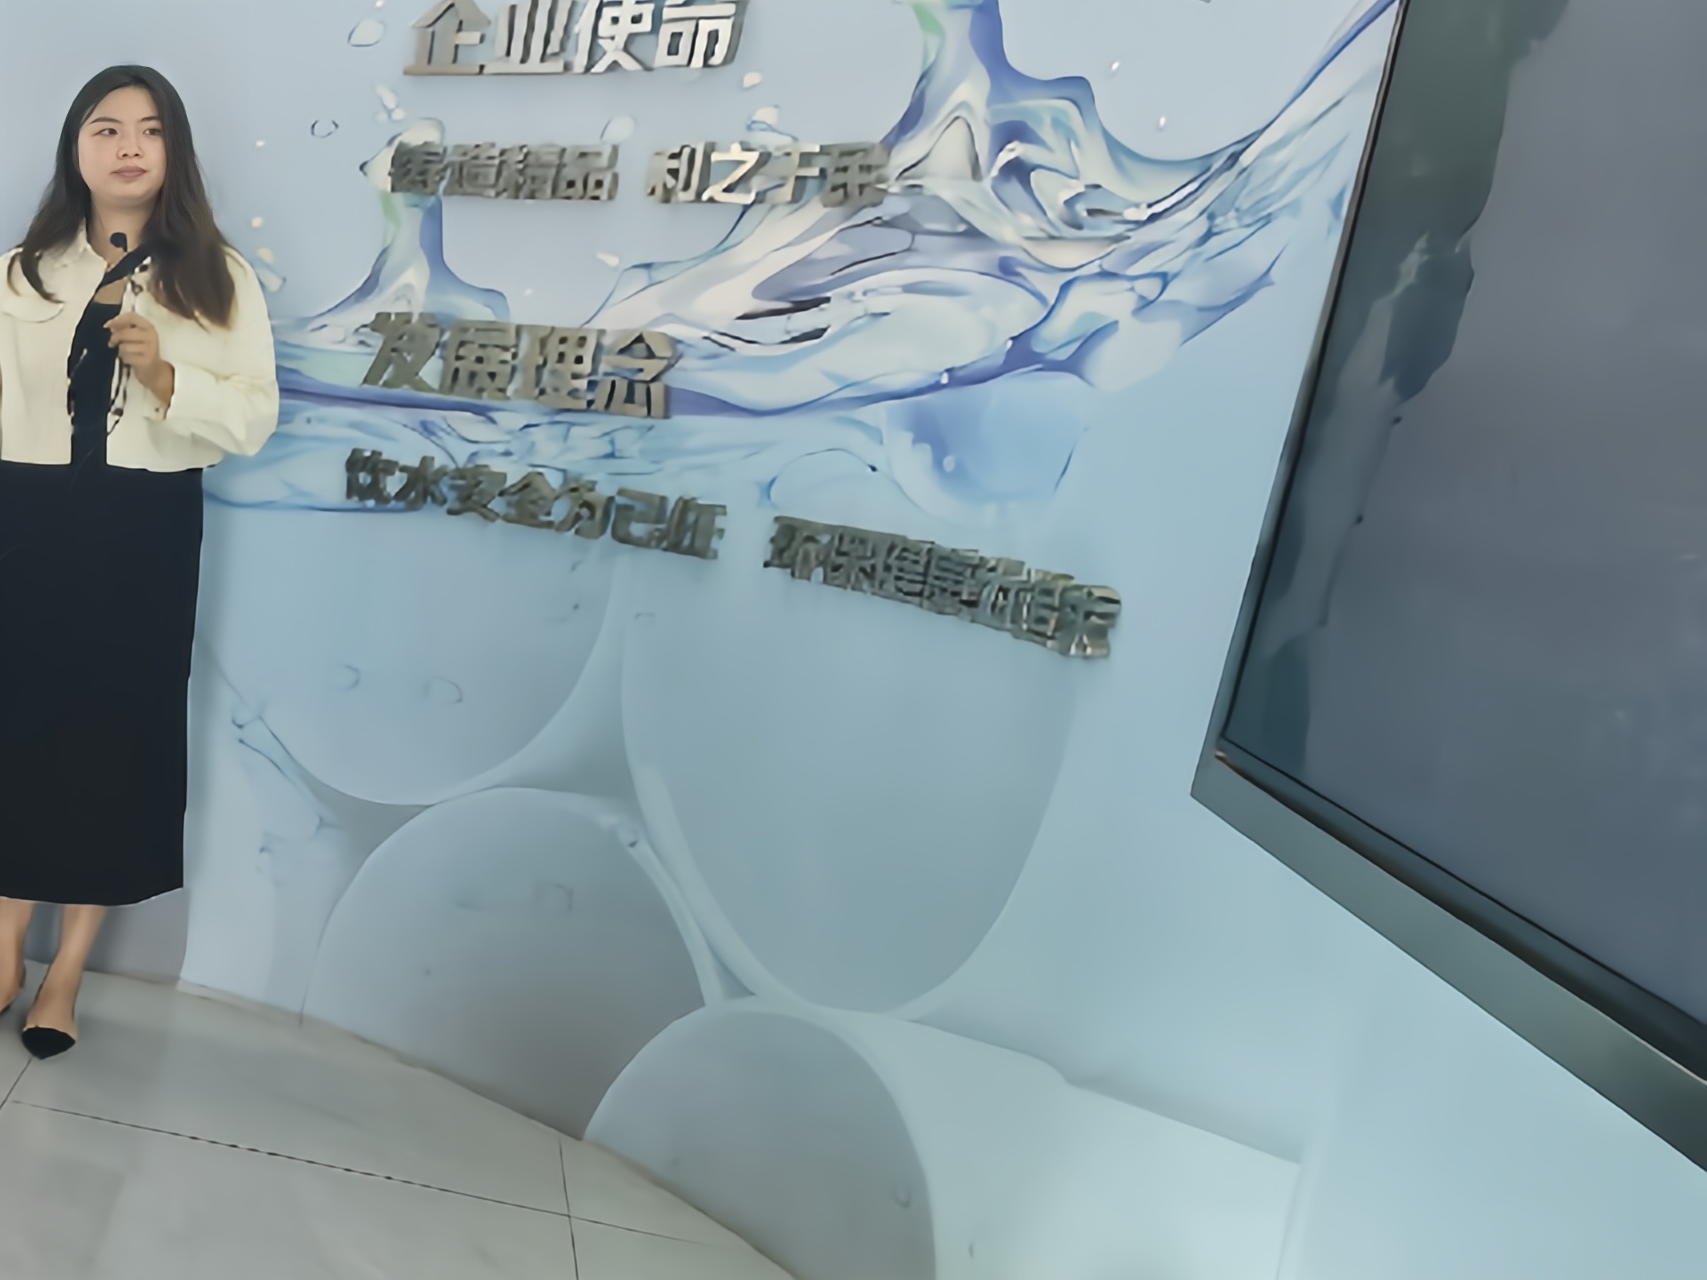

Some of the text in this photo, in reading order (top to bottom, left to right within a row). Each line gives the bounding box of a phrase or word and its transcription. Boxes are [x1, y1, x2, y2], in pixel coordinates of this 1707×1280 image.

[362, 311, 680, 418] 发展理念
[345, 448, 727, 559] 饮水安全为己任
